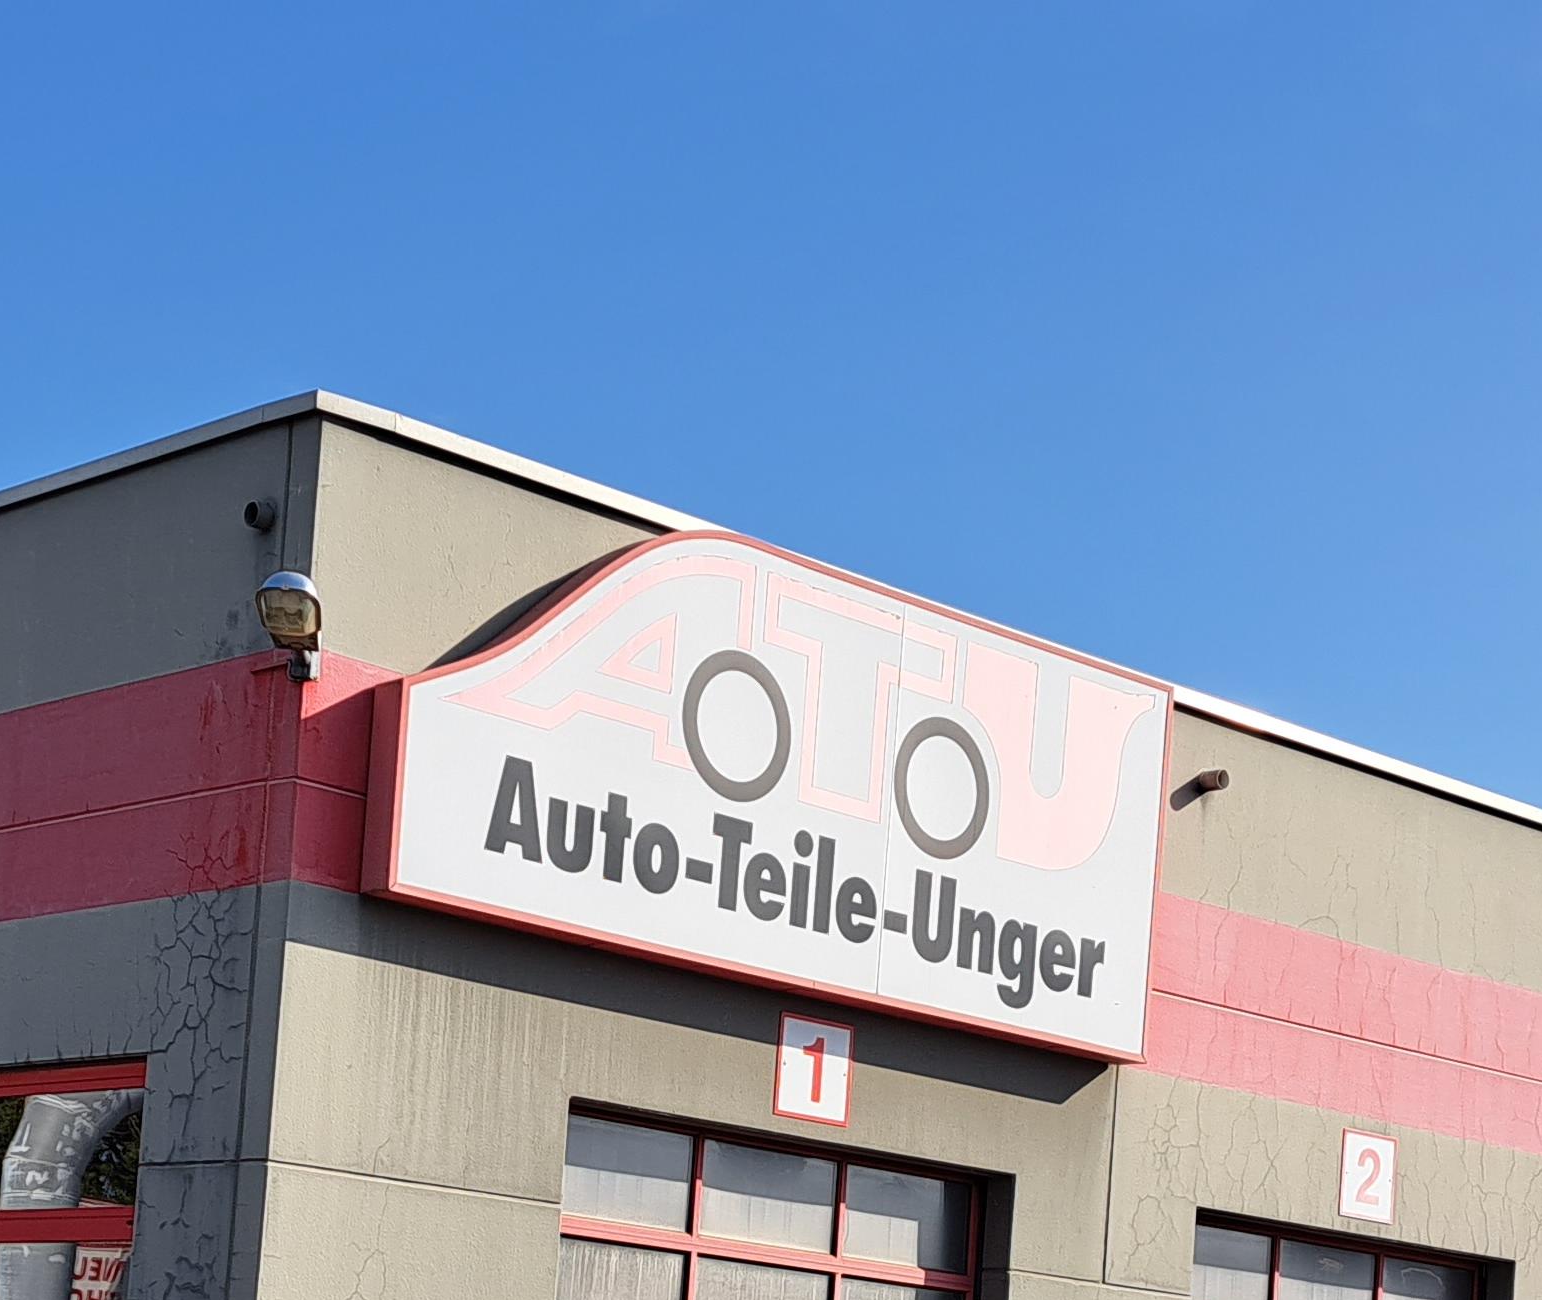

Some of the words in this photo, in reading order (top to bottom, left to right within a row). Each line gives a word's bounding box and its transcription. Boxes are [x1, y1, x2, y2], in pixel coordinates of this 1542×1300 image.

[484, 754, 1106, 1009] Auto-Teile-Unger
[802, 1036, 825, 1103] 1
[1354, 1147, 1381, 1205] 2
